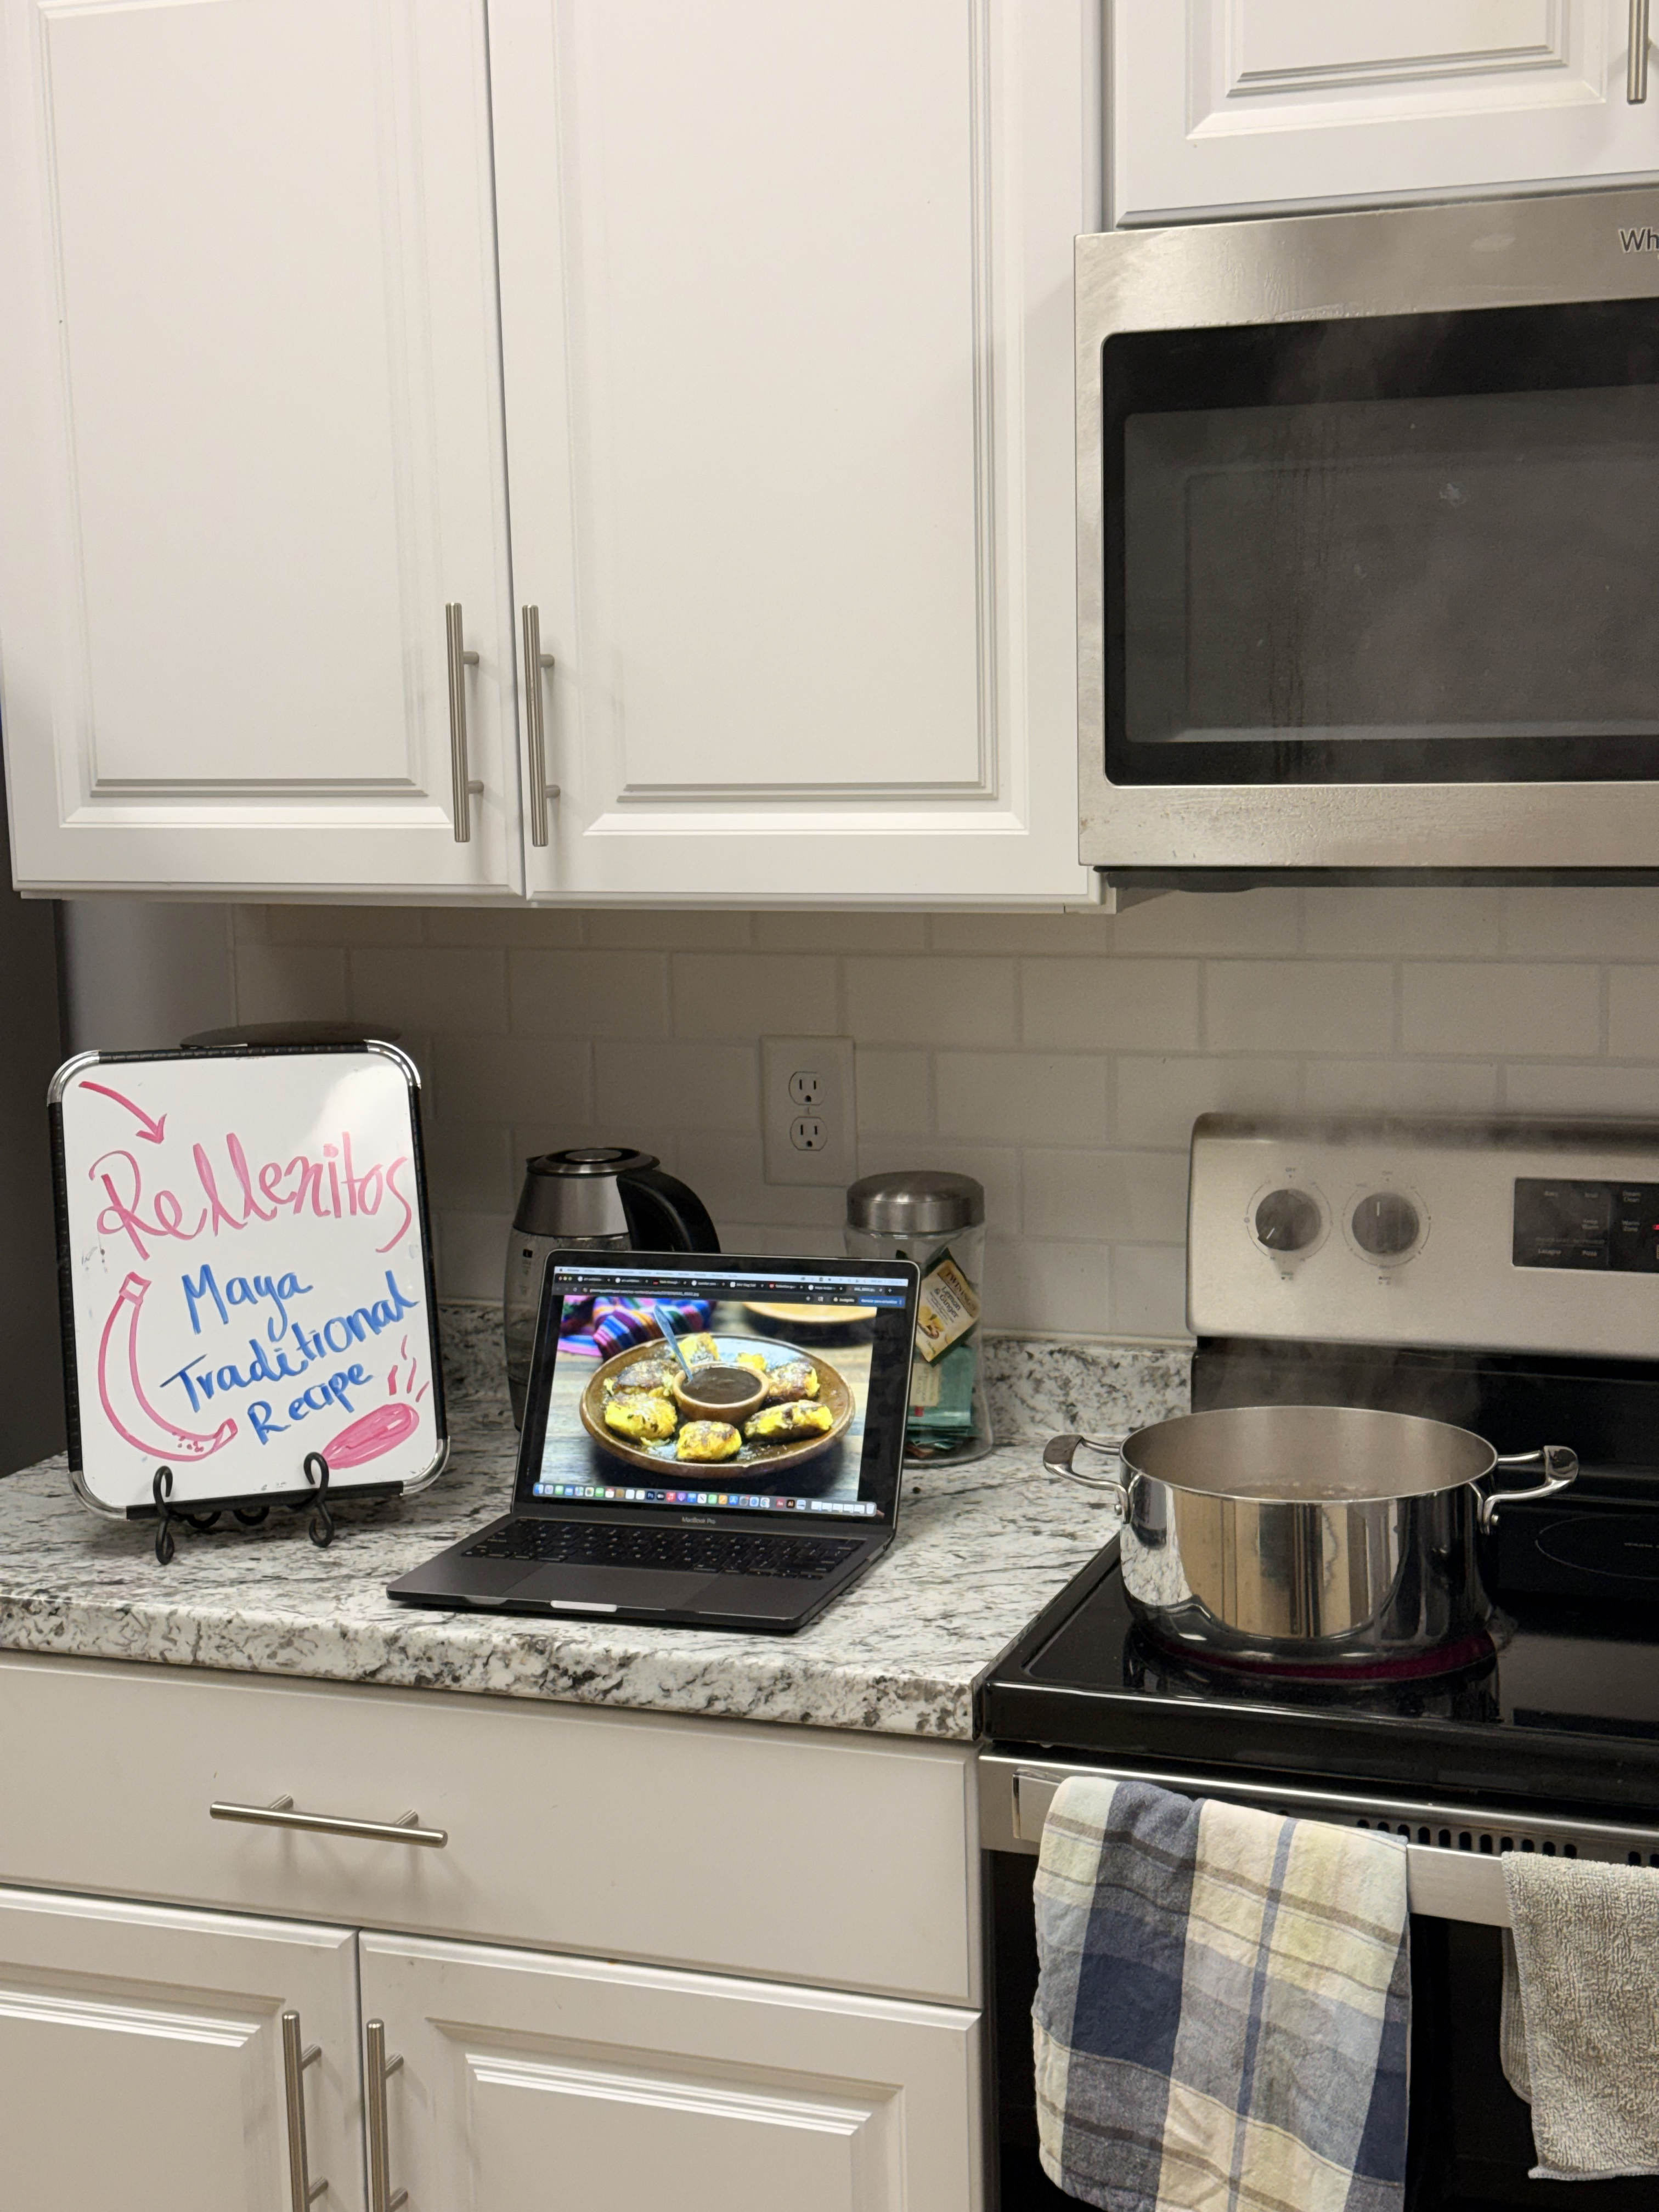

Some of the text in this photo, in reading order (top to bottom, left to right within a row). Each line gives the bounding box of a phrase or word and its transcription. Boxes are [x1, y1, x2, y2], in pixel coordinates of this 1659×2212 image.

[89, 1132, 412, 1261] Rellenitos
[182, 1264, 313, 1342] Maya
[939, 1294, 958, 1318] Ginger
[941, 1286, 961, 1311] Lemon
[160, 1270, 420, 1413] Traditional
[247, 1364, 374, 1445] Recipe
